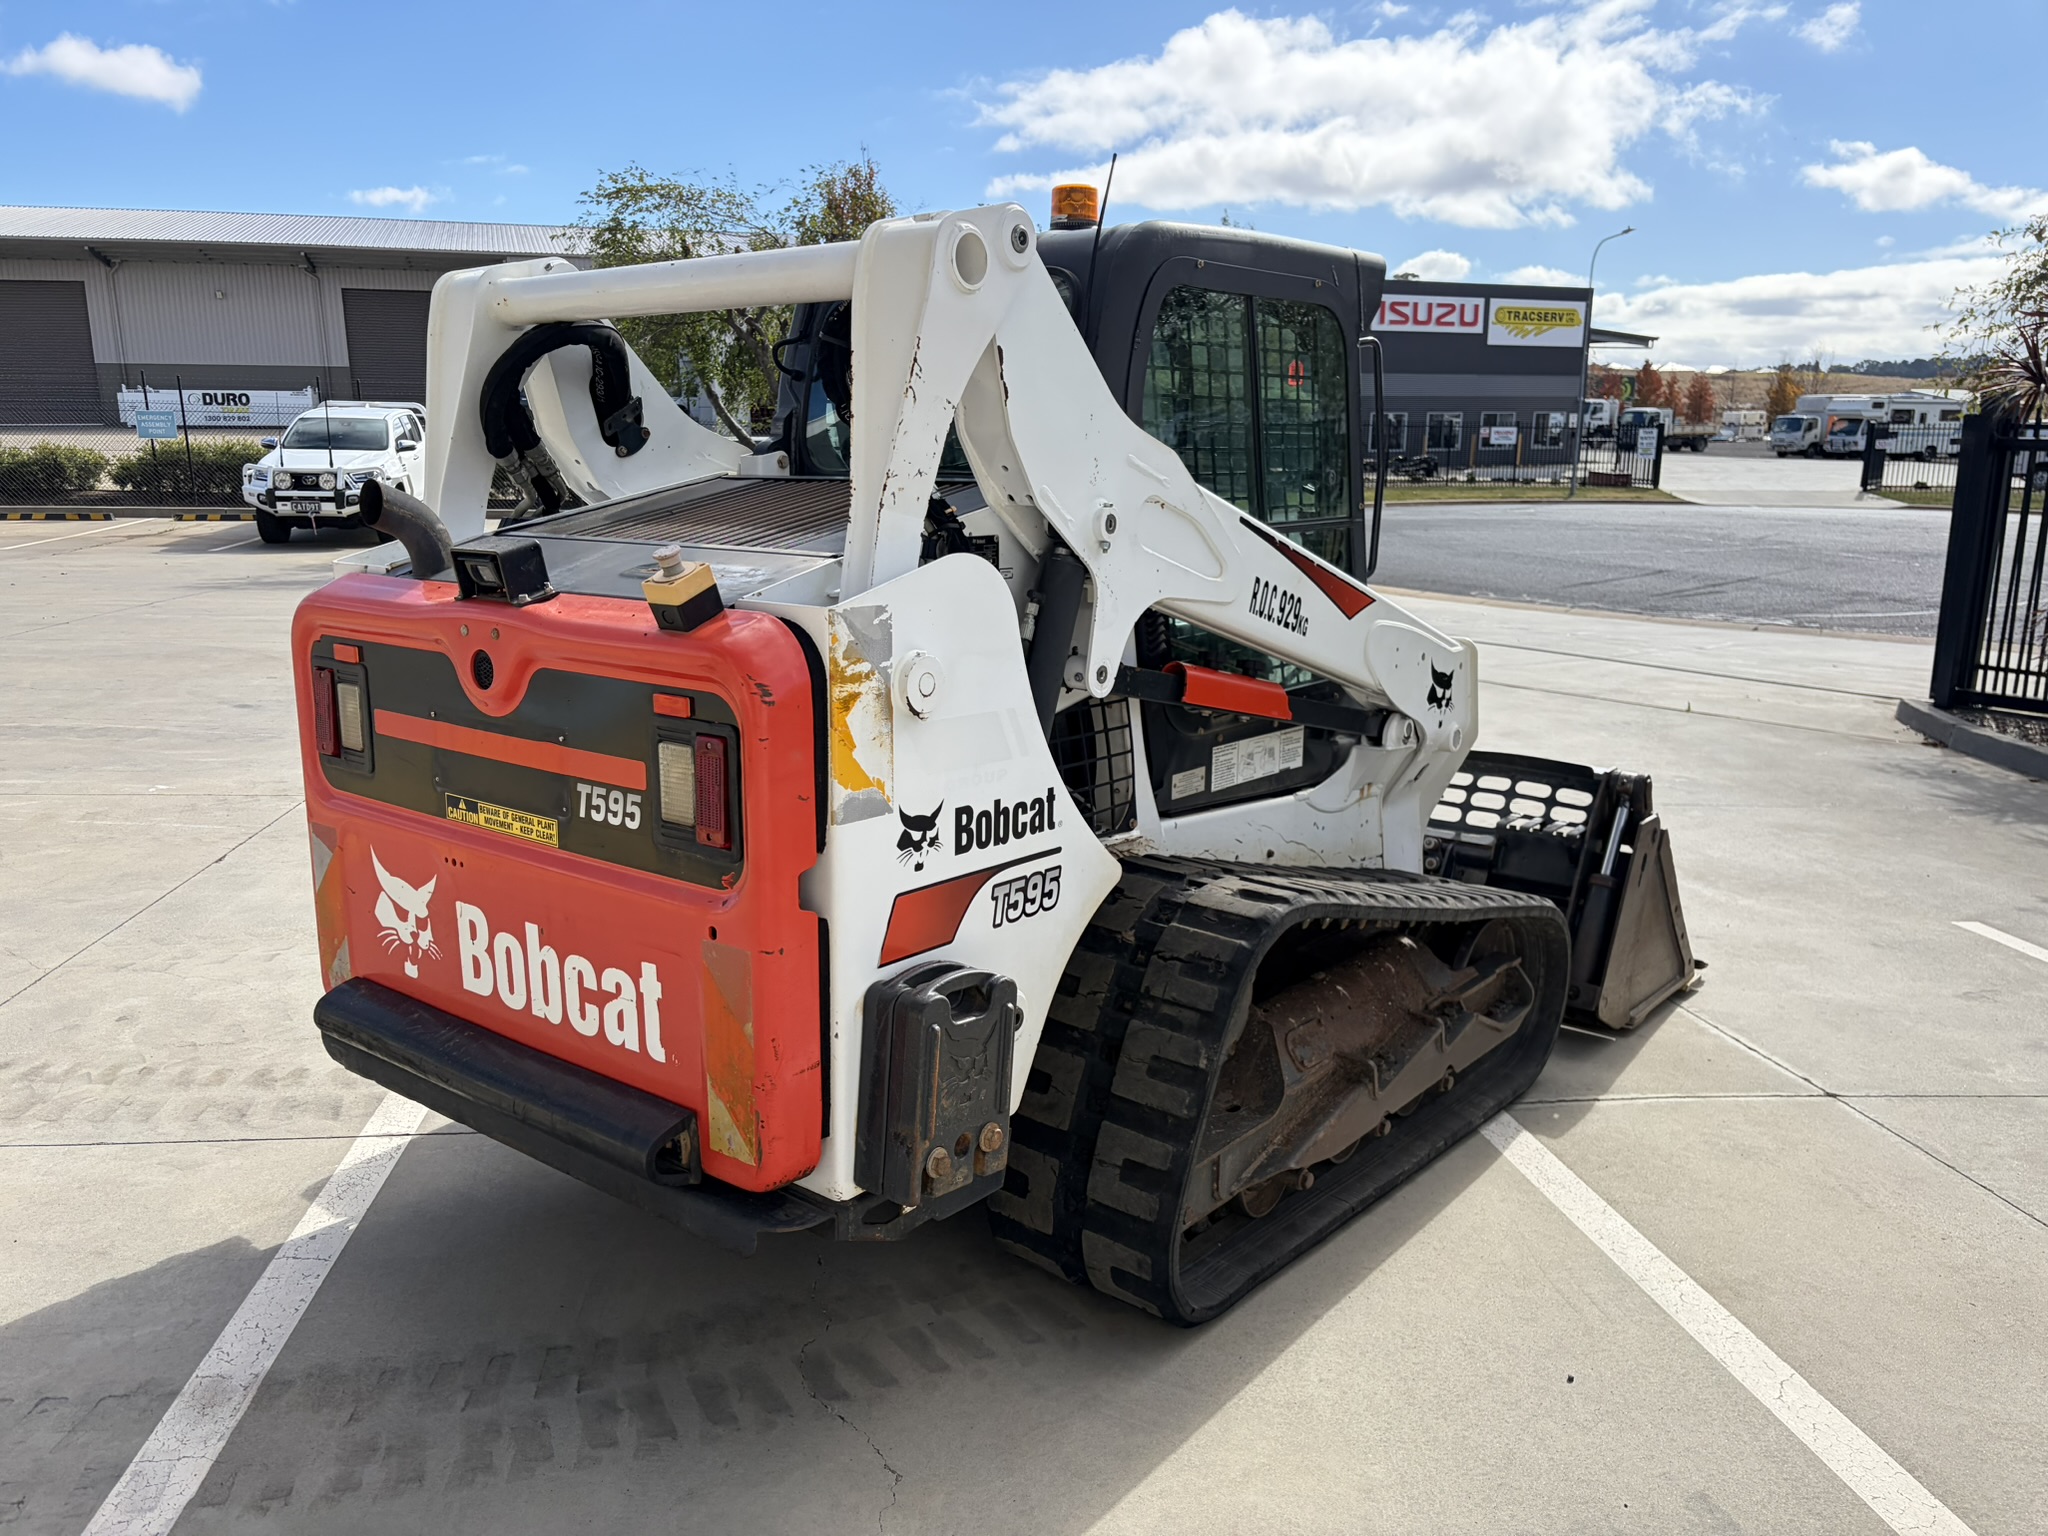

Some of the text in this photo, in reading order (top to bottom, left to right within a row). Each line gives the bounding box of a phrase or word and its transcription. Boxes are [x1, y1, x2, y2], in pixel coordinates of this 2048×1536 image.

[1379, 301, 1480, 327] ISUZU
[1506, 310, 1564, 322] TRACSERV
[201, 392, 250, 406] DURO
[447, 806, 479, 825] CAUTION
[479, 804, 555, 832] BEWARE OF GENERAL PLANT
[576, 783, 642, 830] T595
[484, 816, 514, 831] MOVEMENT
[519, 825, 534, 836] KEEP
[535, 830, 556, 842] CLEAR!
[954, 786, 1056, 856] Bobcat
[991, 865, 1062, 929] T595
[455, 900, 666, 1064] Bobcat
